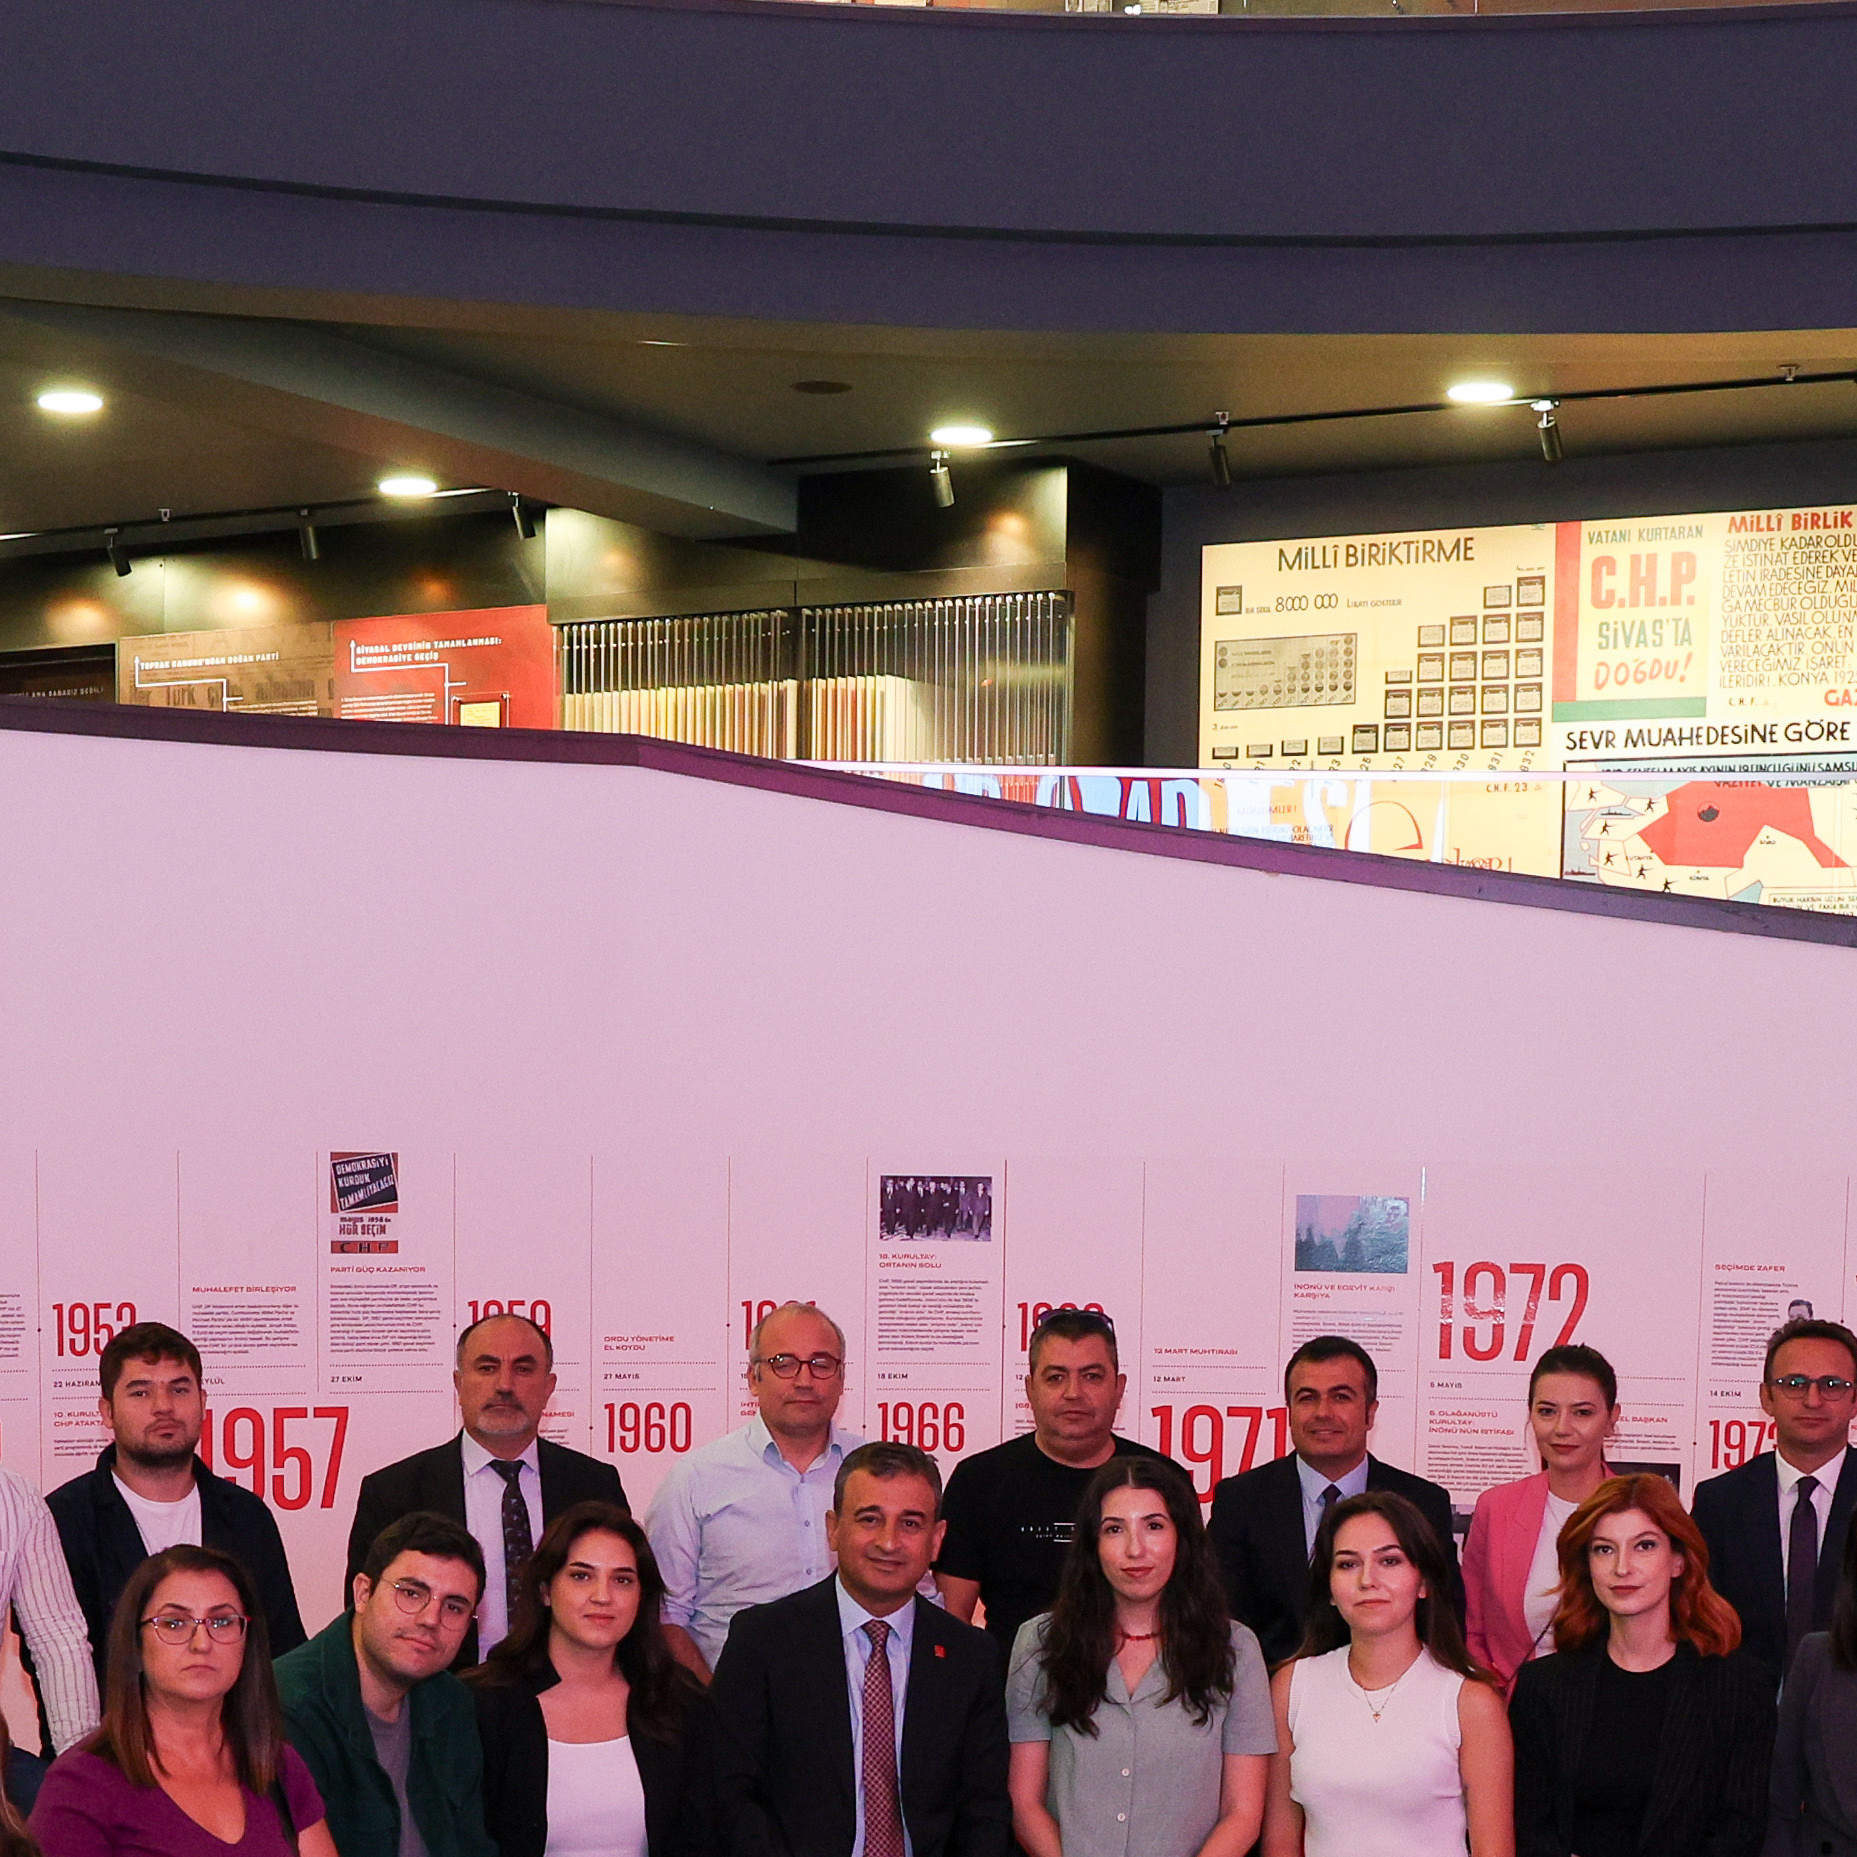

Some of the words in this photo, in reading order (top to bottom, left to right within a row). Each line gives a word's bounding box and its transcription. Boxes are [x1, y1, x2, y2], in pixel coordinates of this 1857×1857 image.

[1588, 529, 1631, 545] VATANI
[1638, 524, 1703, 542] KURTARAN
[1727, 513, 1783, 533] MİLLÎ
[1791, 510, 1853, 531] BİRLİK
[1277, 545, 1339, 572] MİLLÎ
[1345, 536, 1475, 568] BİRİKTİRME
[1779, 534, 1823, 550] KADAR
[1792, 549, 1840, 565] EDEREK
[1590, 551, 1697, 610] C.H.P.
[1722, 582, 1767, 599] DEVAM
[1744, 597, 1797, 612] MECBUR
[1598, 617, 1693, 650] SİVAS'TA
[1721, 629, 1763, 643] DEFLER
[1811, 639, 1855, 655] ONUN
[1594, 651, 1693, 691] DOĞDU!
[1778, 671, 1829, 687] KONYA
[1565, 727, 1616, 750] SEVR
[1624, 722, 1779, 748] MUAHEDESİNE
[1784, 719, 1850, 744] GÖRE
[337, 1173, 372, 1188] KURDUK
[1432, 1261, 1590, 1362] 1972
[604, 1402, 693, 1454] 1960
[877, 1401, 966, 1453] 1966
[201, 1406, 349, 1511] 1957
[1151, 1404, 1291, 1504] 1971
